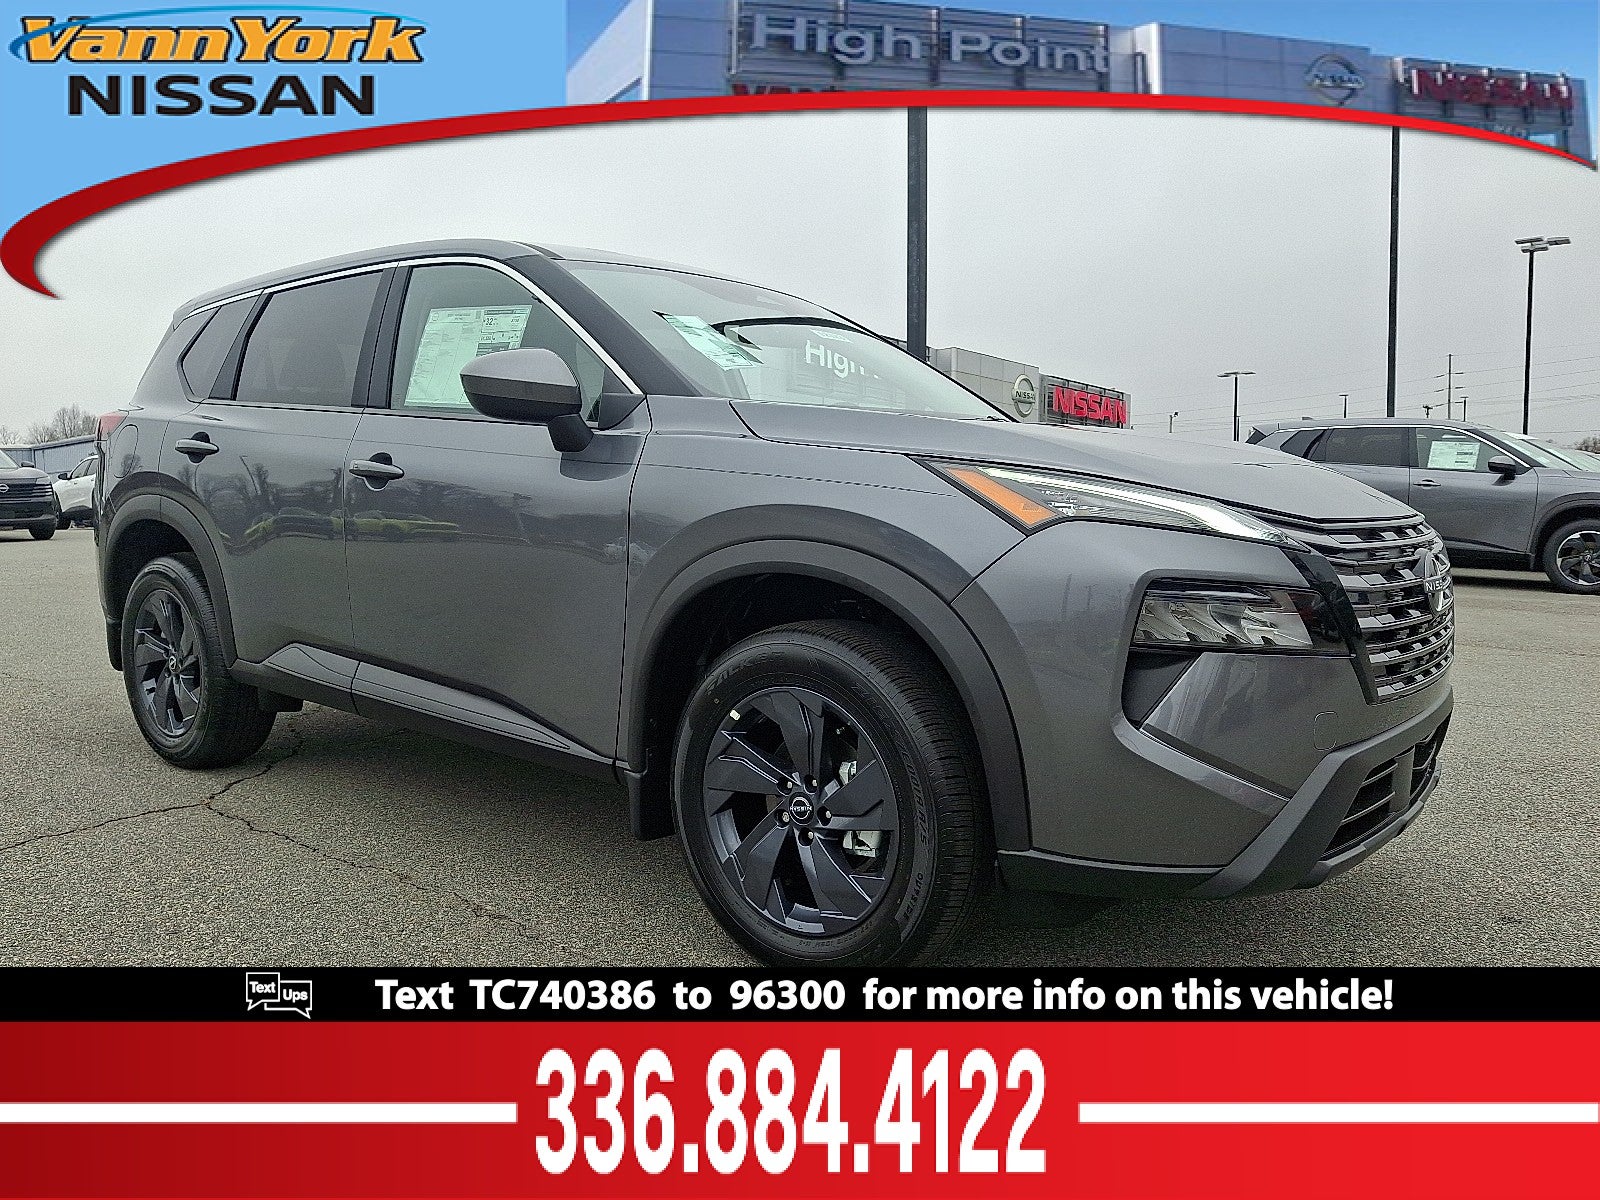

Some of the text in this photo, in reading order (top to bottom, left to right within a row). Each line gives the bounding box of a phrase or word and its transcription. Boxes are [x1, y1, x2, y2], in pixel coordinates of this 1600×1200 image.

[751, 13, 1109, 72] High Point
[1411, 68, 1573, 110] NISSAN
[1053, 386, 1127, 424] NISSAN
